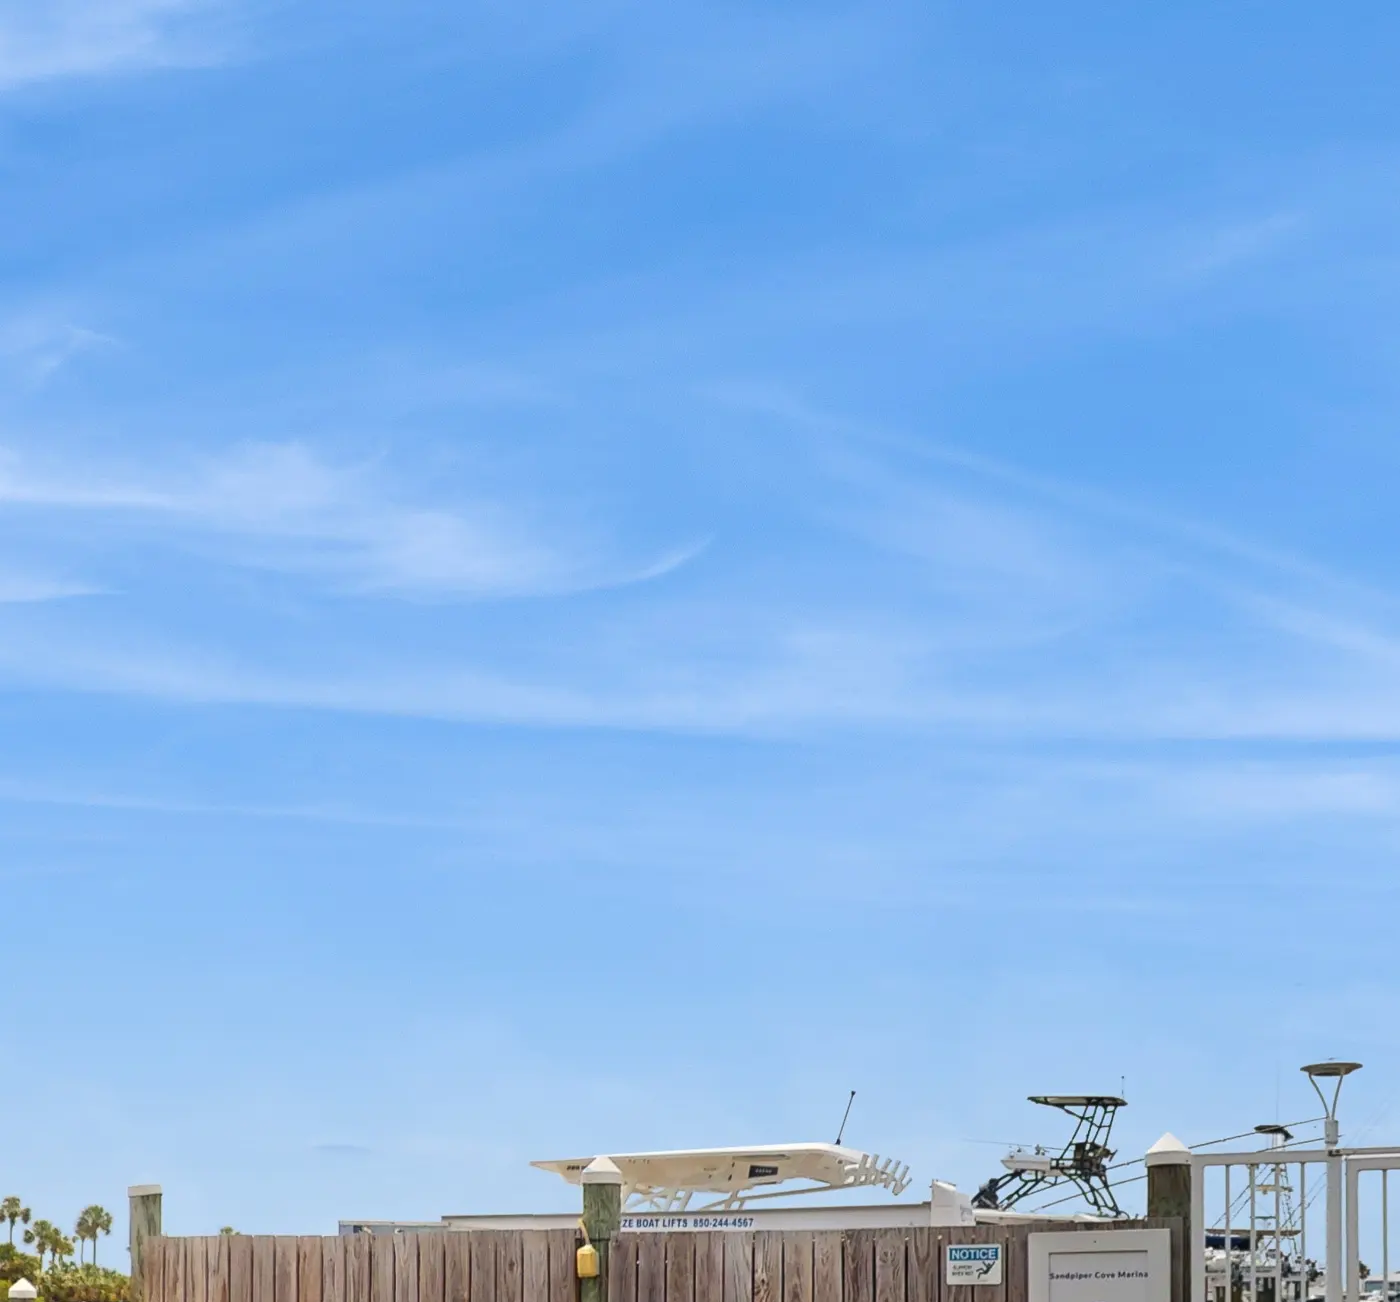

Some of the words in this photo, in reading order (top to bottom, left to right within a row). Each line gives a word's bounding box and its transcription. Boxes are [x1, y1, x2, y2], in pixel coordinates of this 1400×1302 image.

[636, 1218, 660, 1228] BOAT
[662, 1218, 688, 1228] LIFTS
[693, 1217, 754, 1228] 850-244-4567
[951, 1248, 996, 1260] NOTICE
[1049, 1271, 1092, 1280] Sandpiper
[1094, 1271, 1116, 1279] Cove
[1117, 1270, 1149, 1279] Marina
